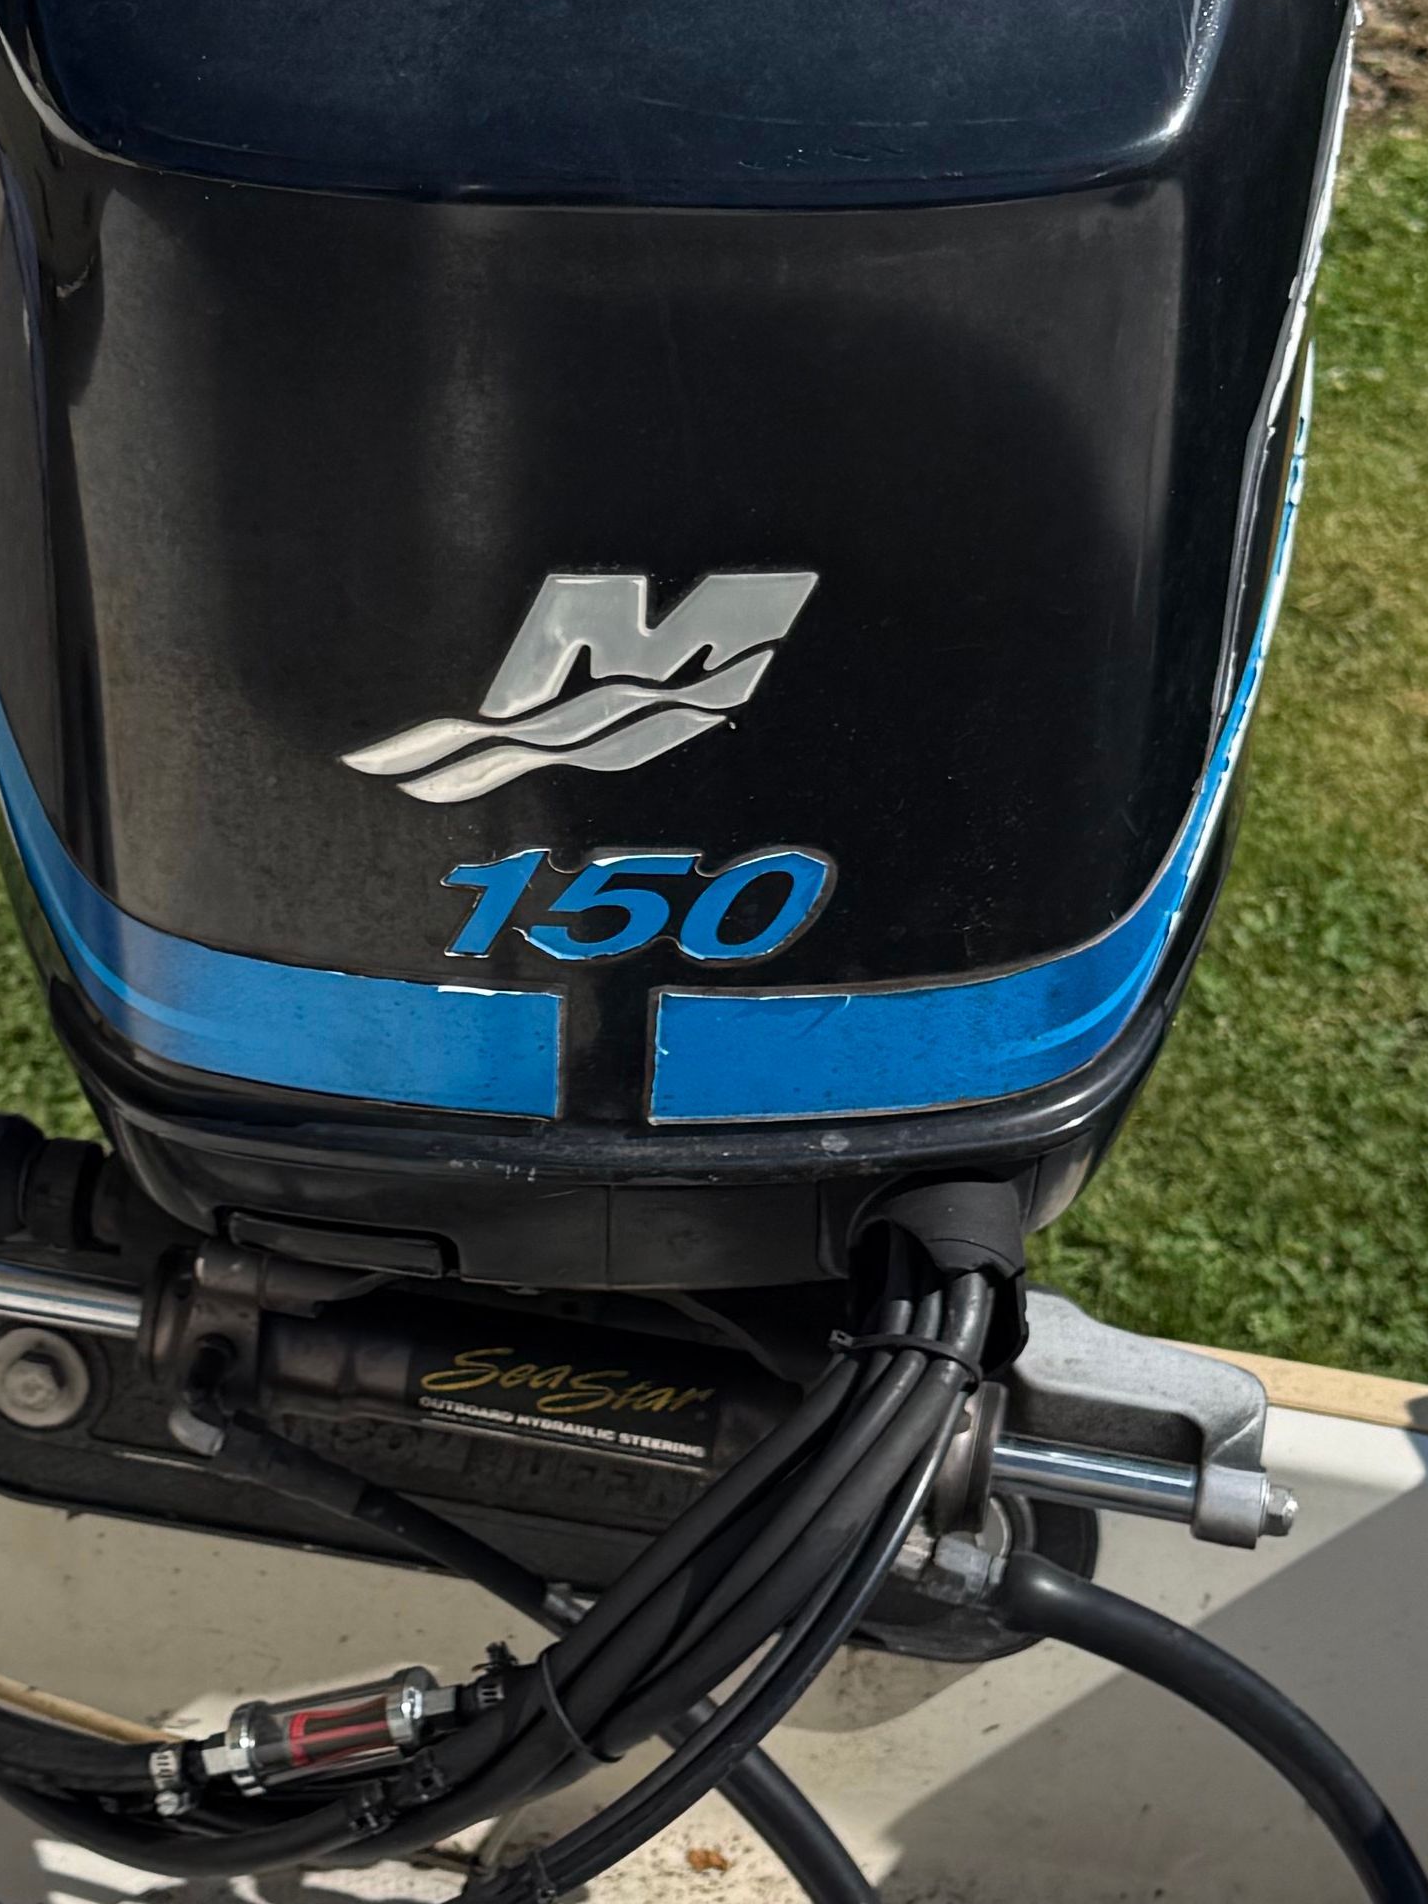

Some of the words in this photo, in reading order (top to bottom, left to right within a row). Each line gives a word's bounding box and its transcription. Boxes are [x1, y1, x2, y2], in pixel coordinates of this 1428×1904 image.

[439, 847, 833, 962] 150
[419, 1395, 515, 1424] OUTBOARD
[515, 1413, 617, 1442] HYDRAULIC
[617, 1432, 707, 1459] STEERING
